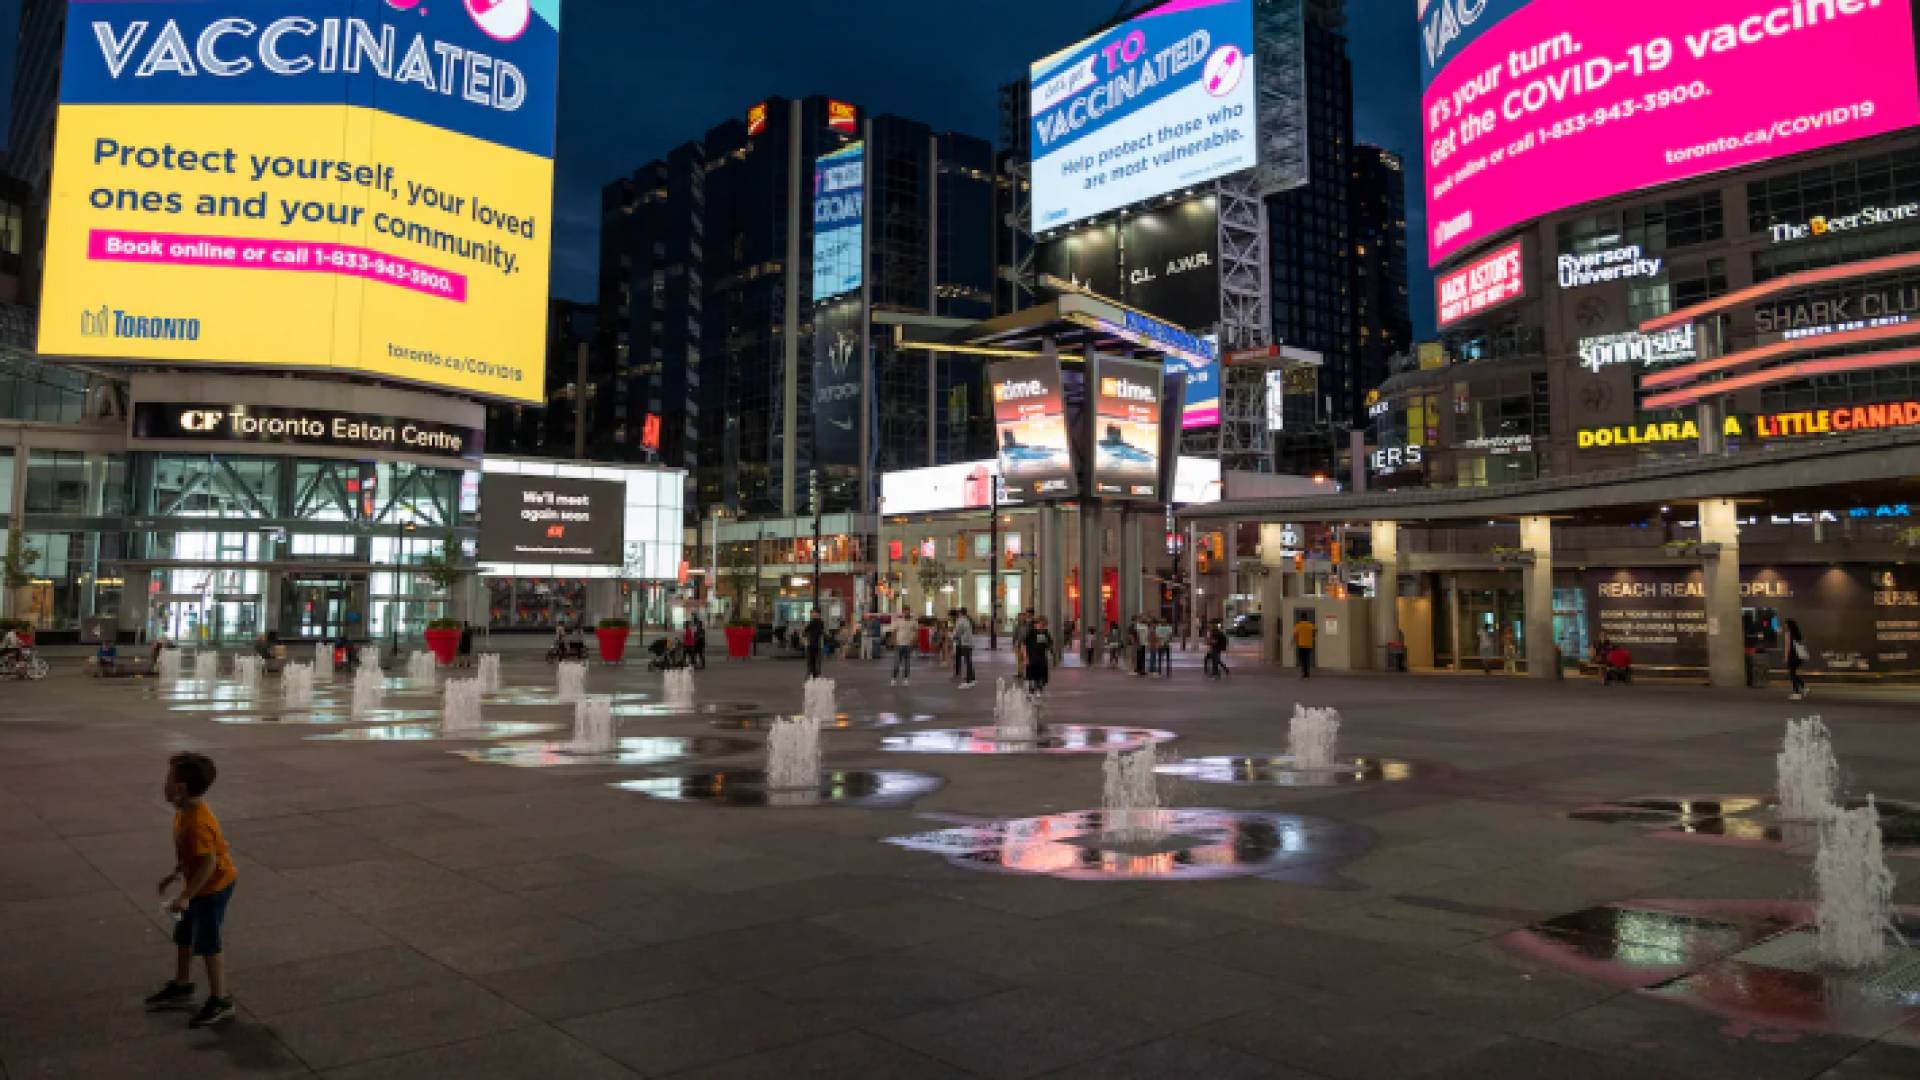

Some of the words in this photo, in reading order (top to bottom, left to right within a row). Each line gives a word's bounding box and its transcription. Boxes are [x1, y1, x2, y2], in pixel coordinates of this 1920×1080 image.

[92, 15, 528, 112] VACCINATED
[1036, 29, 1211, 147] VACCINATED
[1452, 63, 1502, 117] your
[1508, 31, 1583, 79] turn.
[1430, 127, 1457, 168] Get
[1460, 107, 1497, 145] the
[1502, 37, 1673, 121] COVID-19
[1489, 147, 1505, 166] or
[1506, 131, 1535, 157] call
[1538, 80, 1712, 145] 1-833-943-3900.
[1665, 100, 1876, 165] toronto.ca/COVID19
[1061, 155, 1094, 177] Help
[1098, 133, 1154, 169] protect
[1157, 118, 1202, 145] those
[1206, 103, 1243, 126] who
[1082, 172, 1107, 190] are
[1110, 156, 1148, 182] most
[1152, 128, 1245, 168] vulnerable.
[93, 136, 237, 174] Protect
[249, 150, 399, 201] yourself,
[406, 179, 466, 217] your
[471, 196, 536, 241] loved
[88, 186, 183, 214] ones
[195, 189, 268, 220] and
[279, 201, 366, 240] your
[373, 212, 521, 275] community.
[1768, 222, 1809, 244] The
[106, 236, 164, 257] Book
[168, 239, 236, 263] online
[242, 247, 267, 264] or
[271, 246, 309, 266] call
[314, 248, 455, 294] 1-833-943-3900.
[1558, 257, 1662, 289] University
[113, 309, 201, 342] TORONTO
[1754, 296, 1851, 333] SHARK
[229, 410, 325, 437] Toronto
[331, 416, 395, 442] Eaton
[401, 424, 463, 451] Centre
[1577, 415, 1743, 449] DOLLARAA
[1598, 582, 1657, 598] REACH
[1660, 582, 1706, 598] REAL
